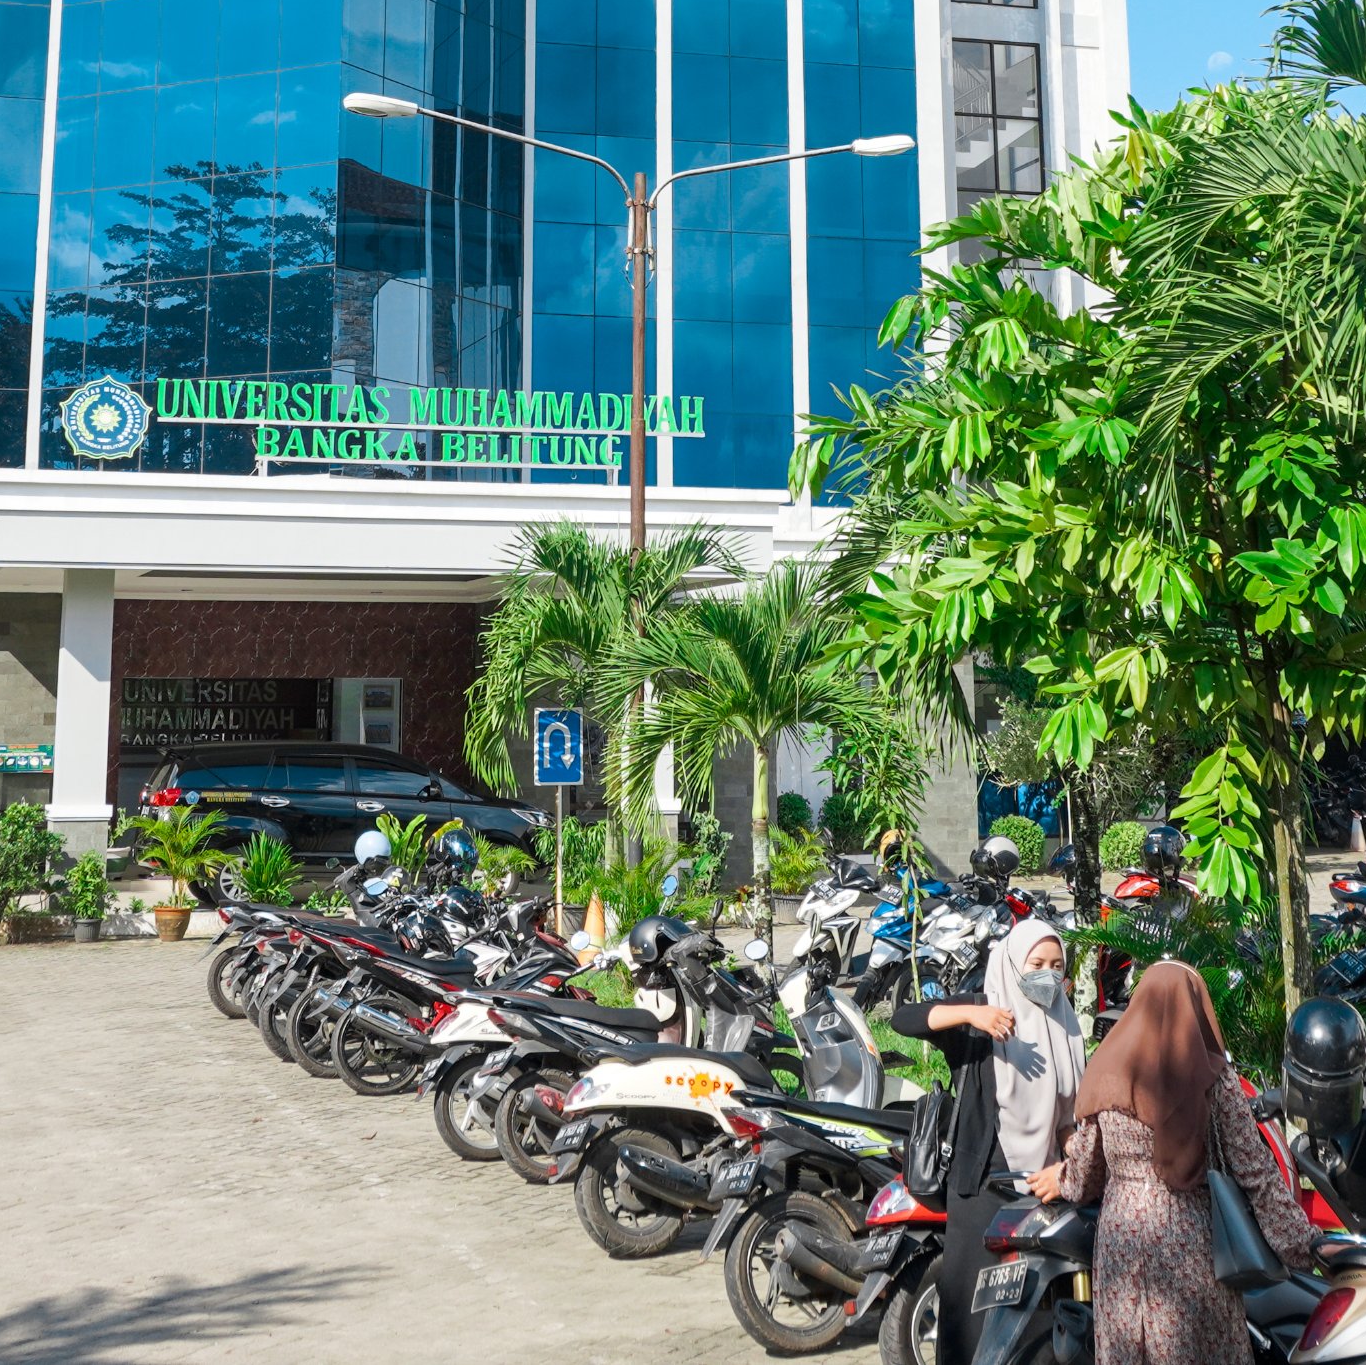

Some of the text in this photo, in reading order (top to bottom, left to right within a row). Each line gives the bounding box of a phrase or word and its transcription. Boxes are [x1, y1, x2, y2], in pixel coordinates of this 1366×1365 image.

[157, 378, 705, 433] UNIVERSITAS MUHAMMADIYAH
[255, 427, 623, 466] BANGKA BELITUNG
[124, 680, 277, 702] UNIVERSITAS
[664, 1076, 734, 1095] scoopy
[988, 1266, 1011, 1288] 6765
[1012, 1264, 1026, 1283] VF
